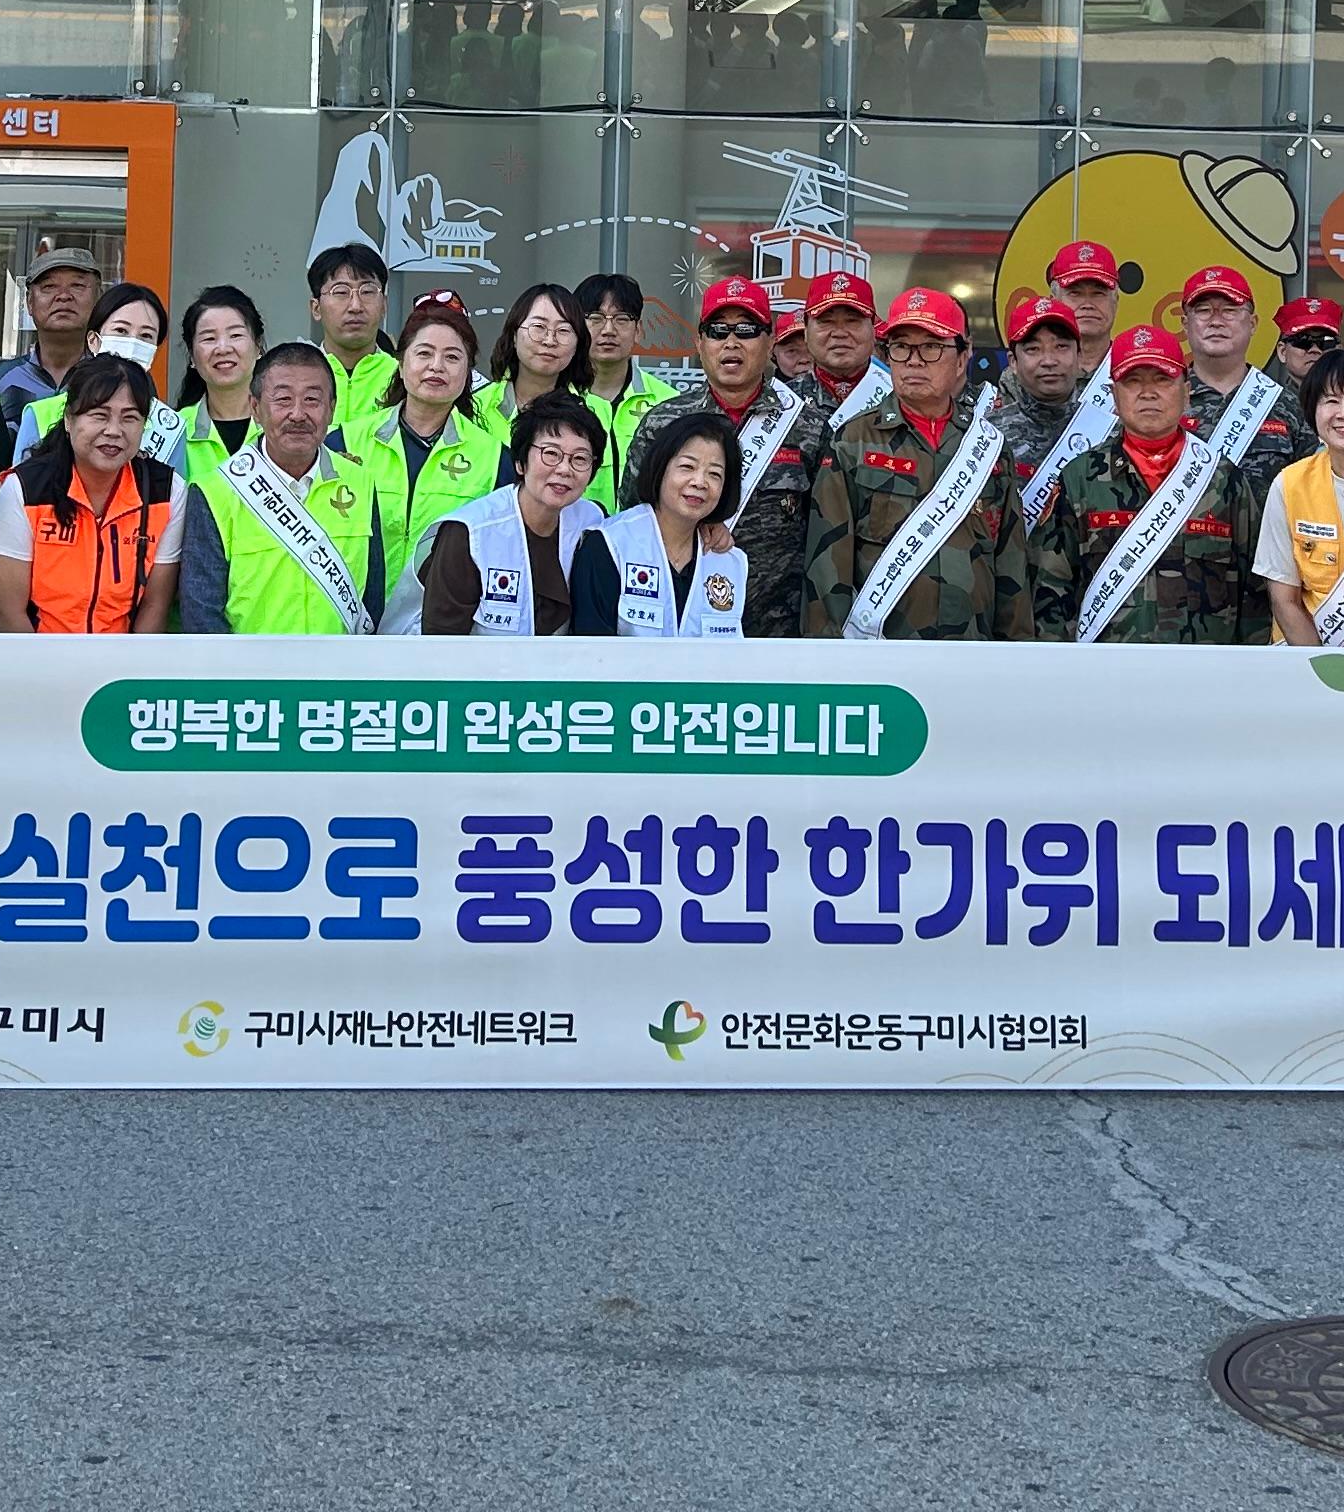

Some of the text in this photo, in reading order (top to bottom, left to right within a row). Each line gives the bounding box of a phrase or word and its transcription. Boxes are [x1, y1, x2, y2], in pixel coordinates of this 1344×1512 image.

[248, 474, 316, 546] 대한민국
[917, 472, 973, 539] 안전사고를
[1119, 501, 1177, 573] 안전사고를
[869, 536, 922, 609] 예방합시다
[484, 612, 513, 625] 간호사
[627, 607, 656, 622] 간호사
[128, 699, 883, 757] 행복한 명절의 완성은 안전입니다
[455, 814, 779, 944] 풍성한
[804, 815, 1119, 947] 한가위
[245, 1008, 577, 1048] 구미시재난안전네트워크
[721, 1011, 1088, 1052] 안전문화운동구미시협의회
